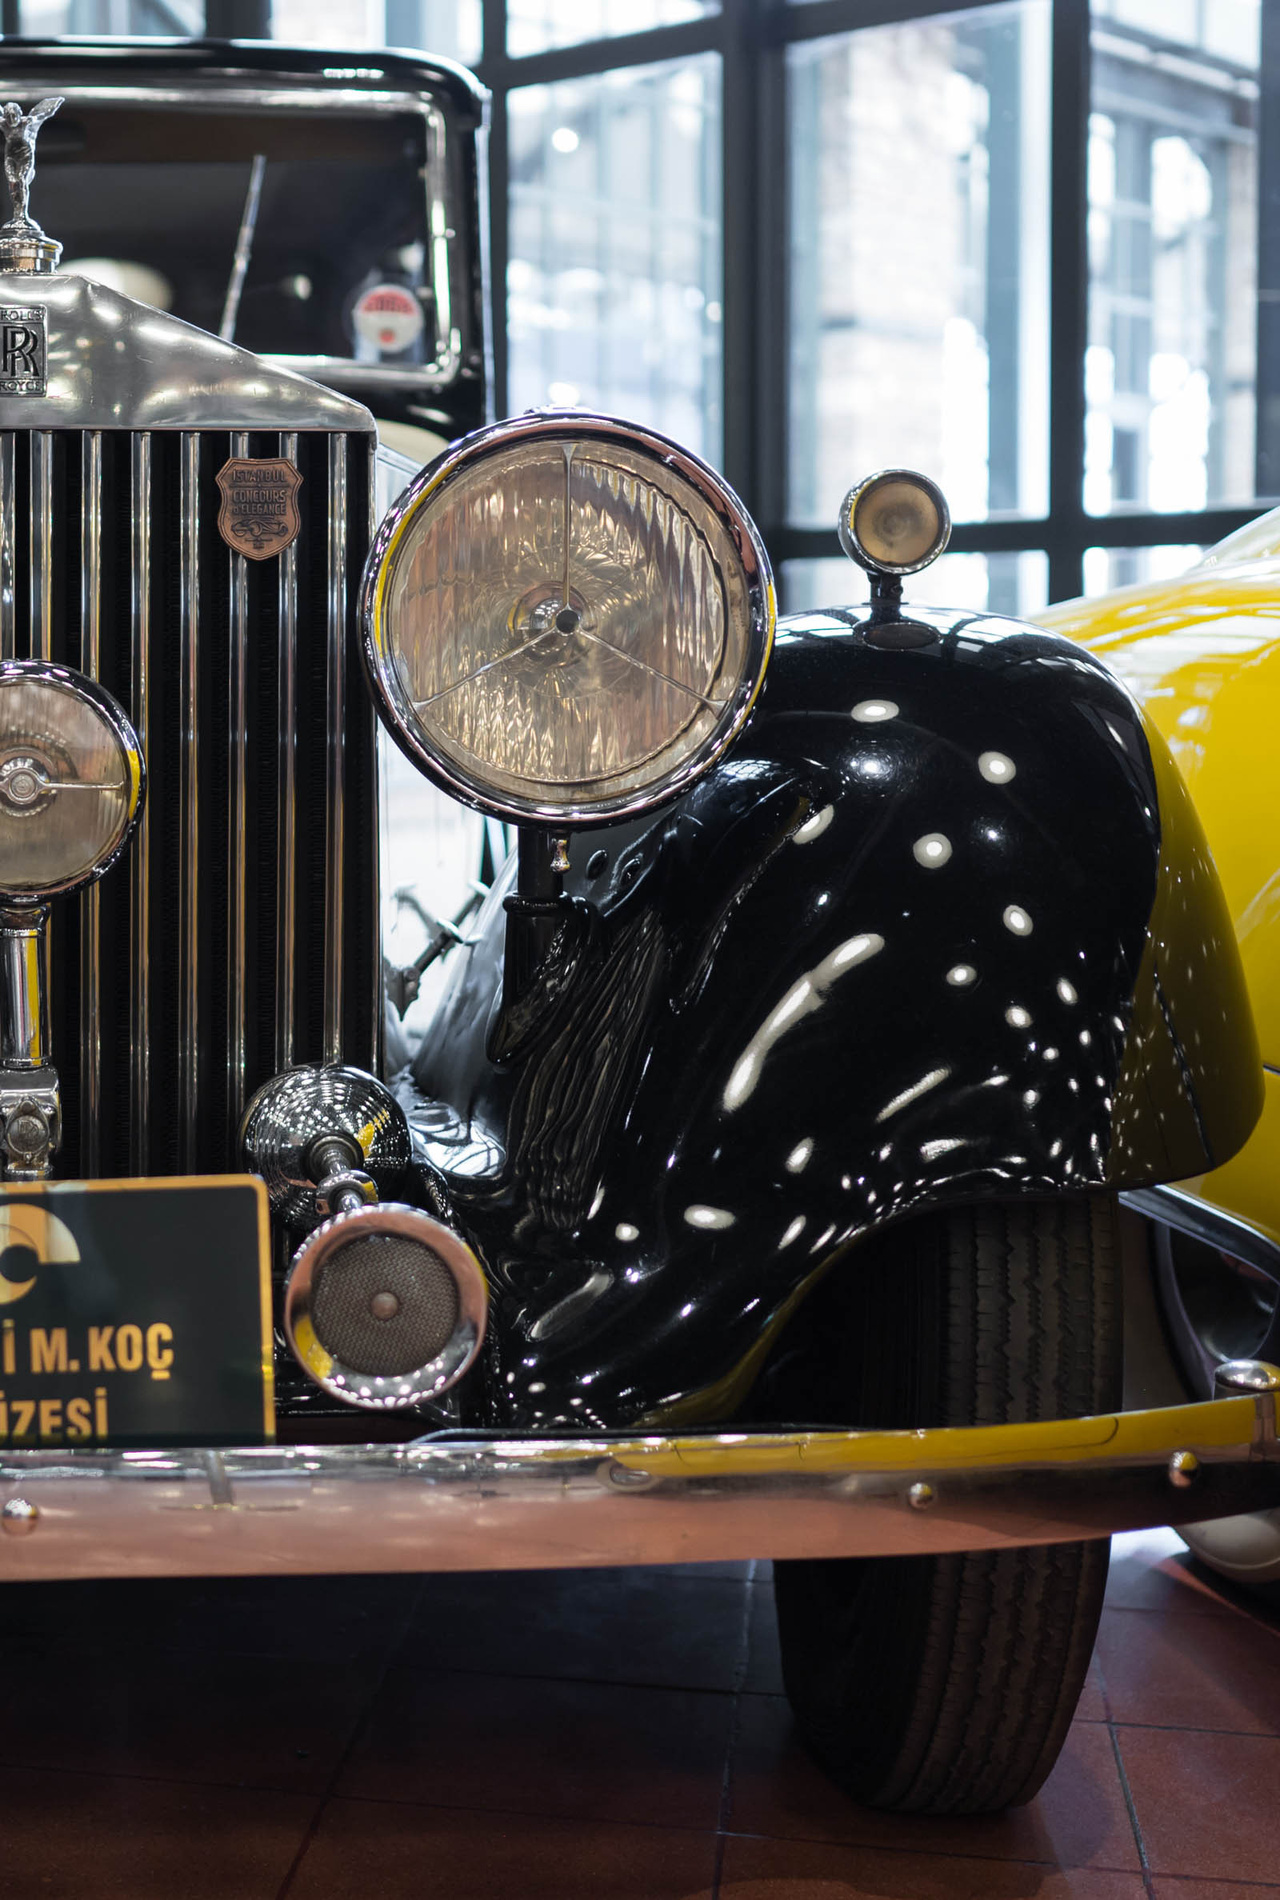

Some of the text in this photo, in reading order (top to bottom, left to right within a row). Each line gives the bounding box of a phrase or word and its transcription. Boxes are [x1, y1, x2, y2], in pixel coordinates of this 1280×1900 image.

[0, 310, 42, 320] ROLLS
[0, 380, 40, 391] ROYCE
[233, 489, 286, 503] CONCOURS
[30, 1328, 80, 1373] M.
[88, 1323, 174, 1380] KOÇ
